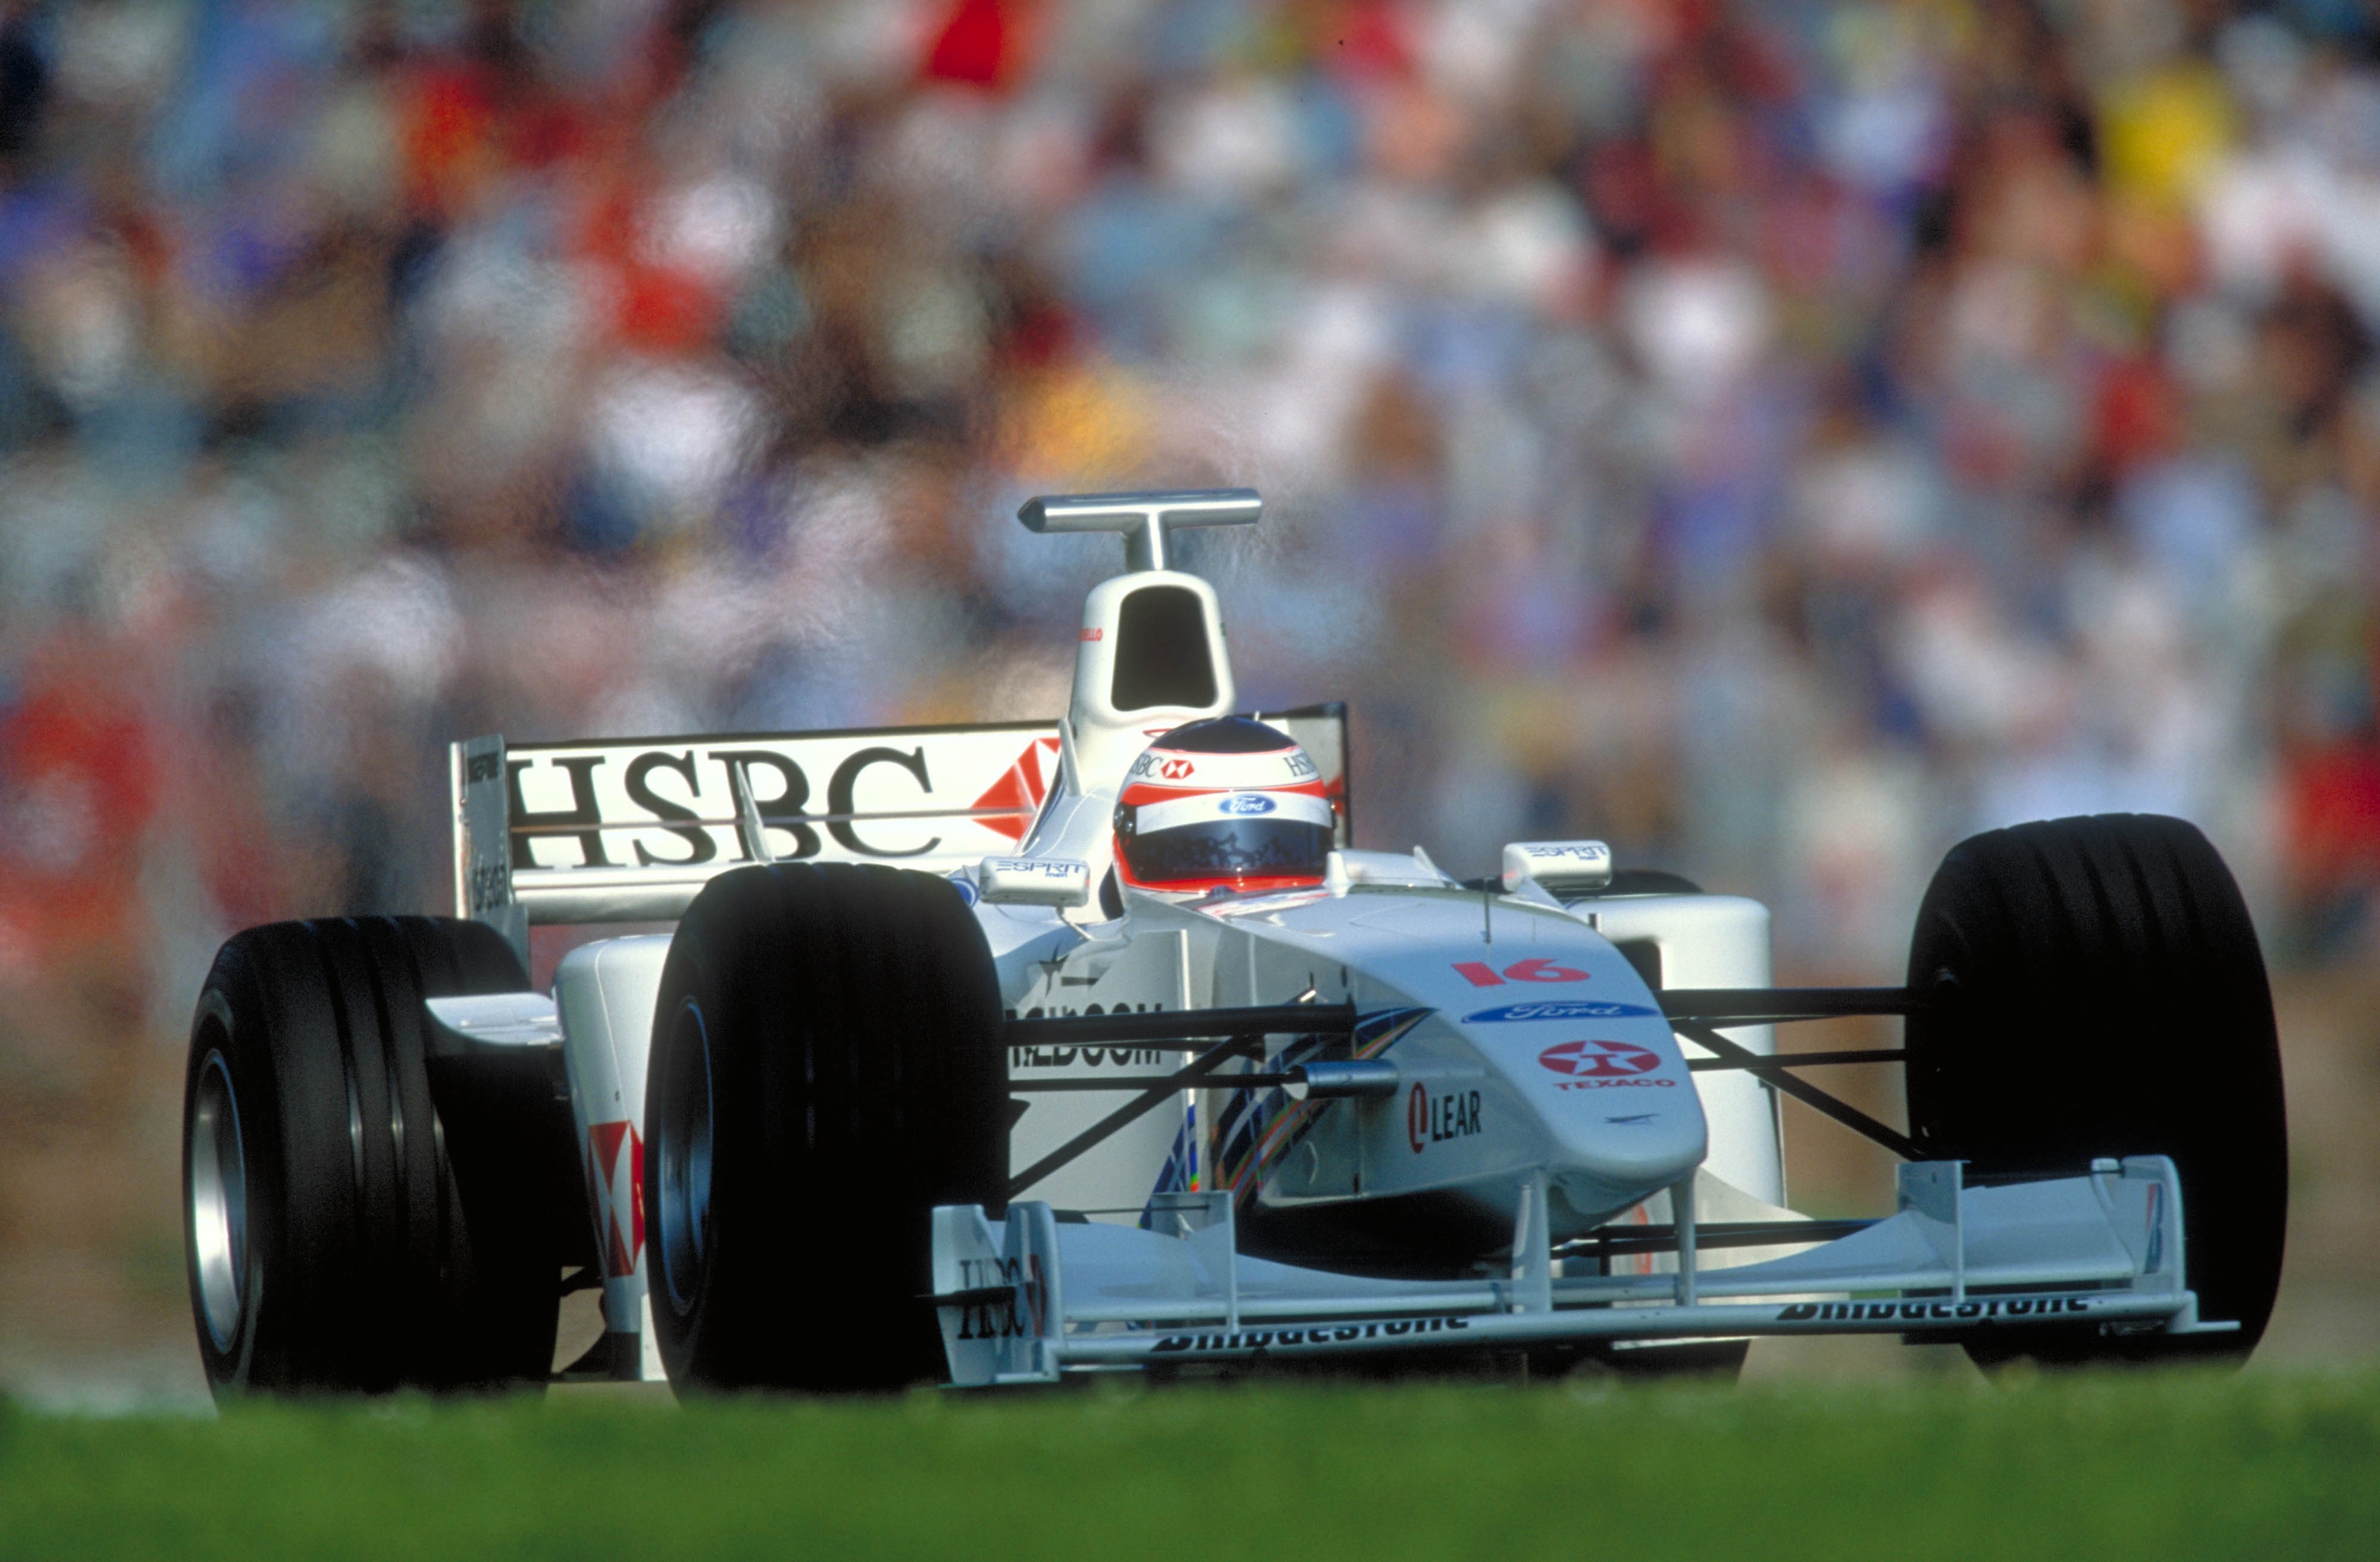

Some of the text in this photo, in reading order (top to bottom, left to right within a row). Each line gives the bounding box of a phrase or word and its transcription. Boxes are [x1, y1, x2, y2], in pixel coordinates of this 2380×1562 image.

[508, 747, 942, 868] HSBC
[1229, 797, 1266, 813] Ford
[996, 861, 1086, 873] ESPRIT
[1451, 958, 1591, 987] 16
[1504, 1002, 1621, 1020] Ford
[1554, 1079, 1676, 1090] TEXACO
[1432, 1090, 1481, 1141] LEAR
